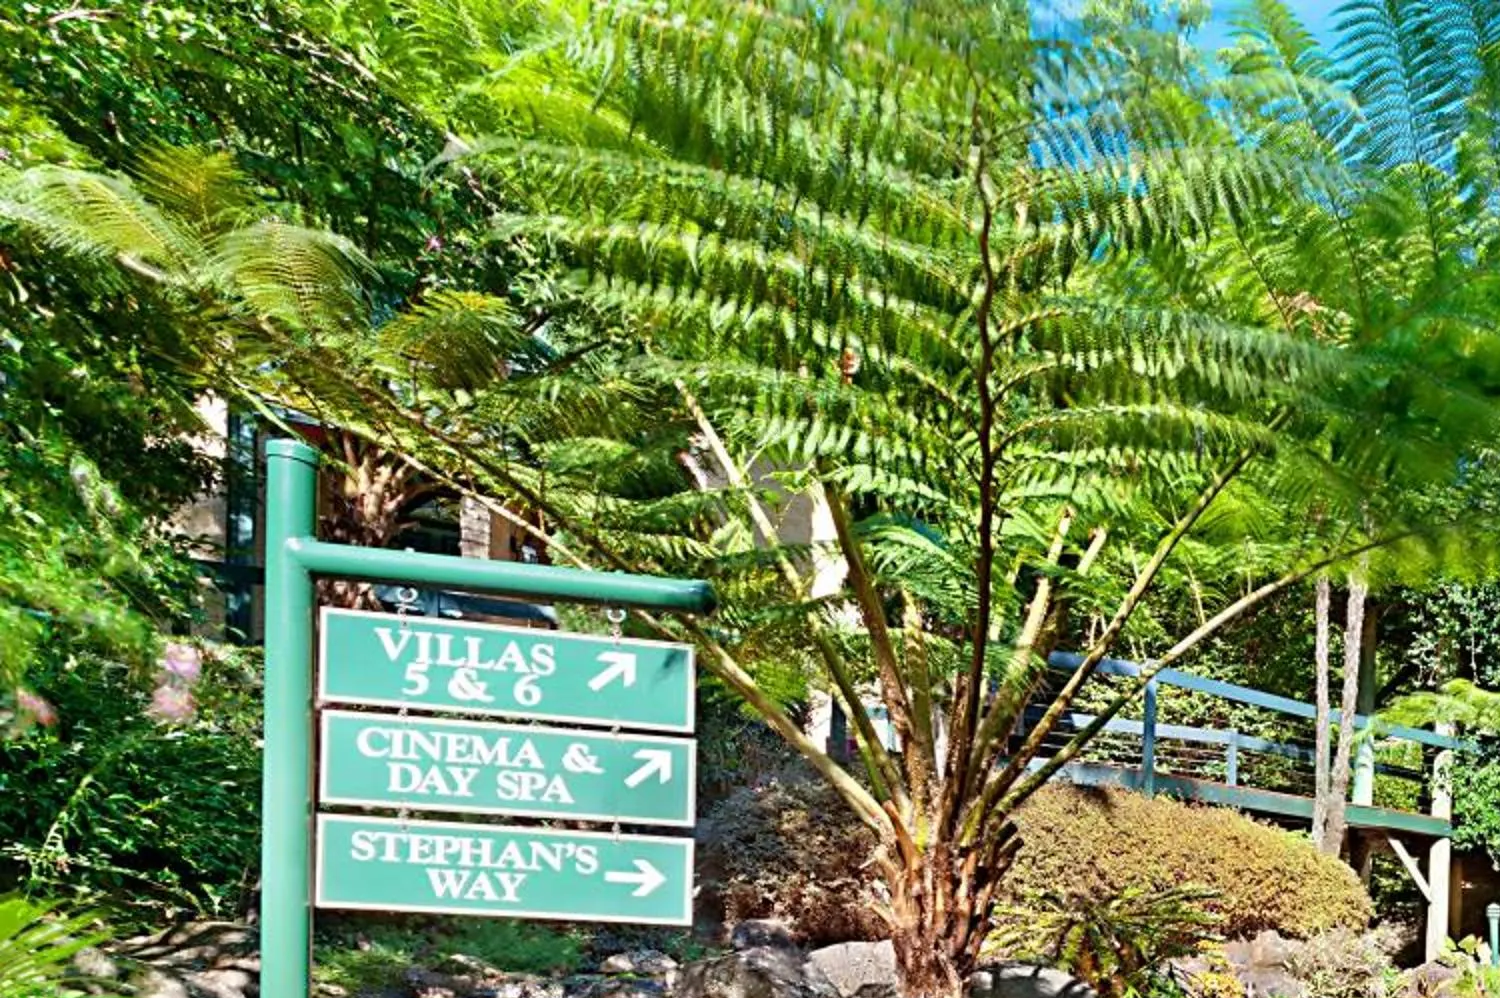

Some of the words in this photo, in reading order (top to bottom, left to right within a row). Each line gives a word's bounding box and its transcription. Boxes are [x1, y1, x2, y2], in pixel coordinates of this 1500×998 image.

[375, 628, 555, 676] VILLAS
[402, 664, 429, 695] 5
[448, 667, 494, 702] &
[513, 673, 543, 705] 6
[356, 727, 544, 768] CINEMA
[561, 743, 605, 774] &
[386, 762, 479, 797] DAY
[497, 773, 574, 804] SPA
[351, 830, 598, 874] STEPHAN'S
[426, 868, 526, 902] WAY
